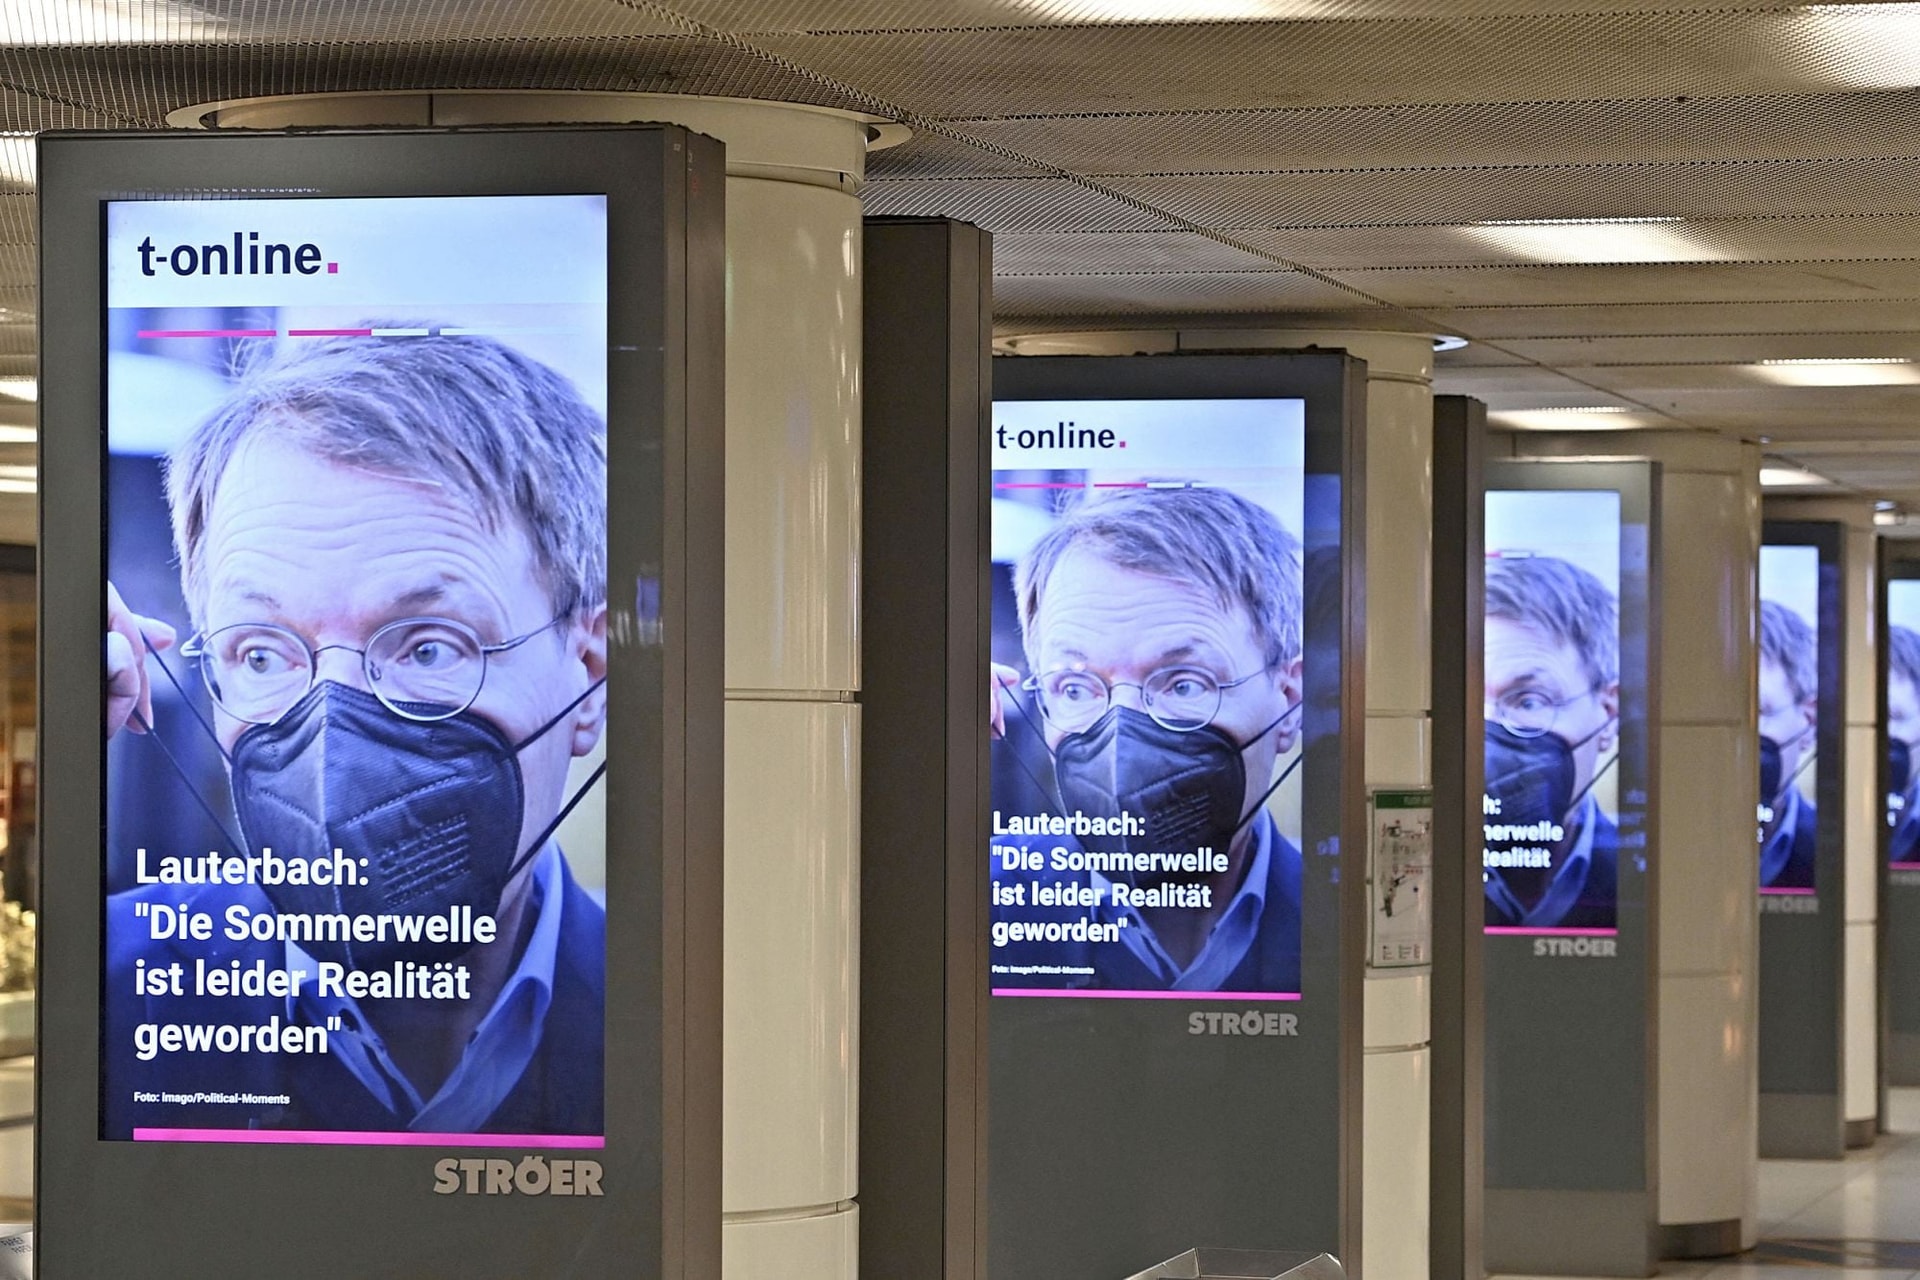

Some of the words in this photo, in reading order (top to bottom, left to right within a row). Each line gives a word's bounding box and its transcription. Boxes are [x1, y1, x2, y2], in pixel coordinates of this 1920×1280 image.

[137, 231, 339, 277] t-online.
[996, 421, 1126, 449] t-online.
[992, 810, 1146, 836] Lauterbach:
[136, 848, 369, 886] Lauterbach:
[992, 845, 1044, 871] "Die
[1050, 847, 1229, 873] Sommerwelle
[992, 880, 1025, 906] ist
[1031, 881, 1105, 907] leider
[1111, 883, 1212, 908] Realität
[135, 903, 213, 940] "Die
[224, 905, 497, 943] Sommerwelle
[991, 917, 1128, 946] geworden"
[135, 958, 184, 996] ist
[196, 958, 307, 998] leider
[318, 961, 471, 1000] Realität
[134, 1015, 342, 1061] geworden"
[1188, 1010, 1298, 1037] STRÖER
[133, 1091, 160, 1103] Foto:
[433, 1156, 605, 1197] STRÖER
